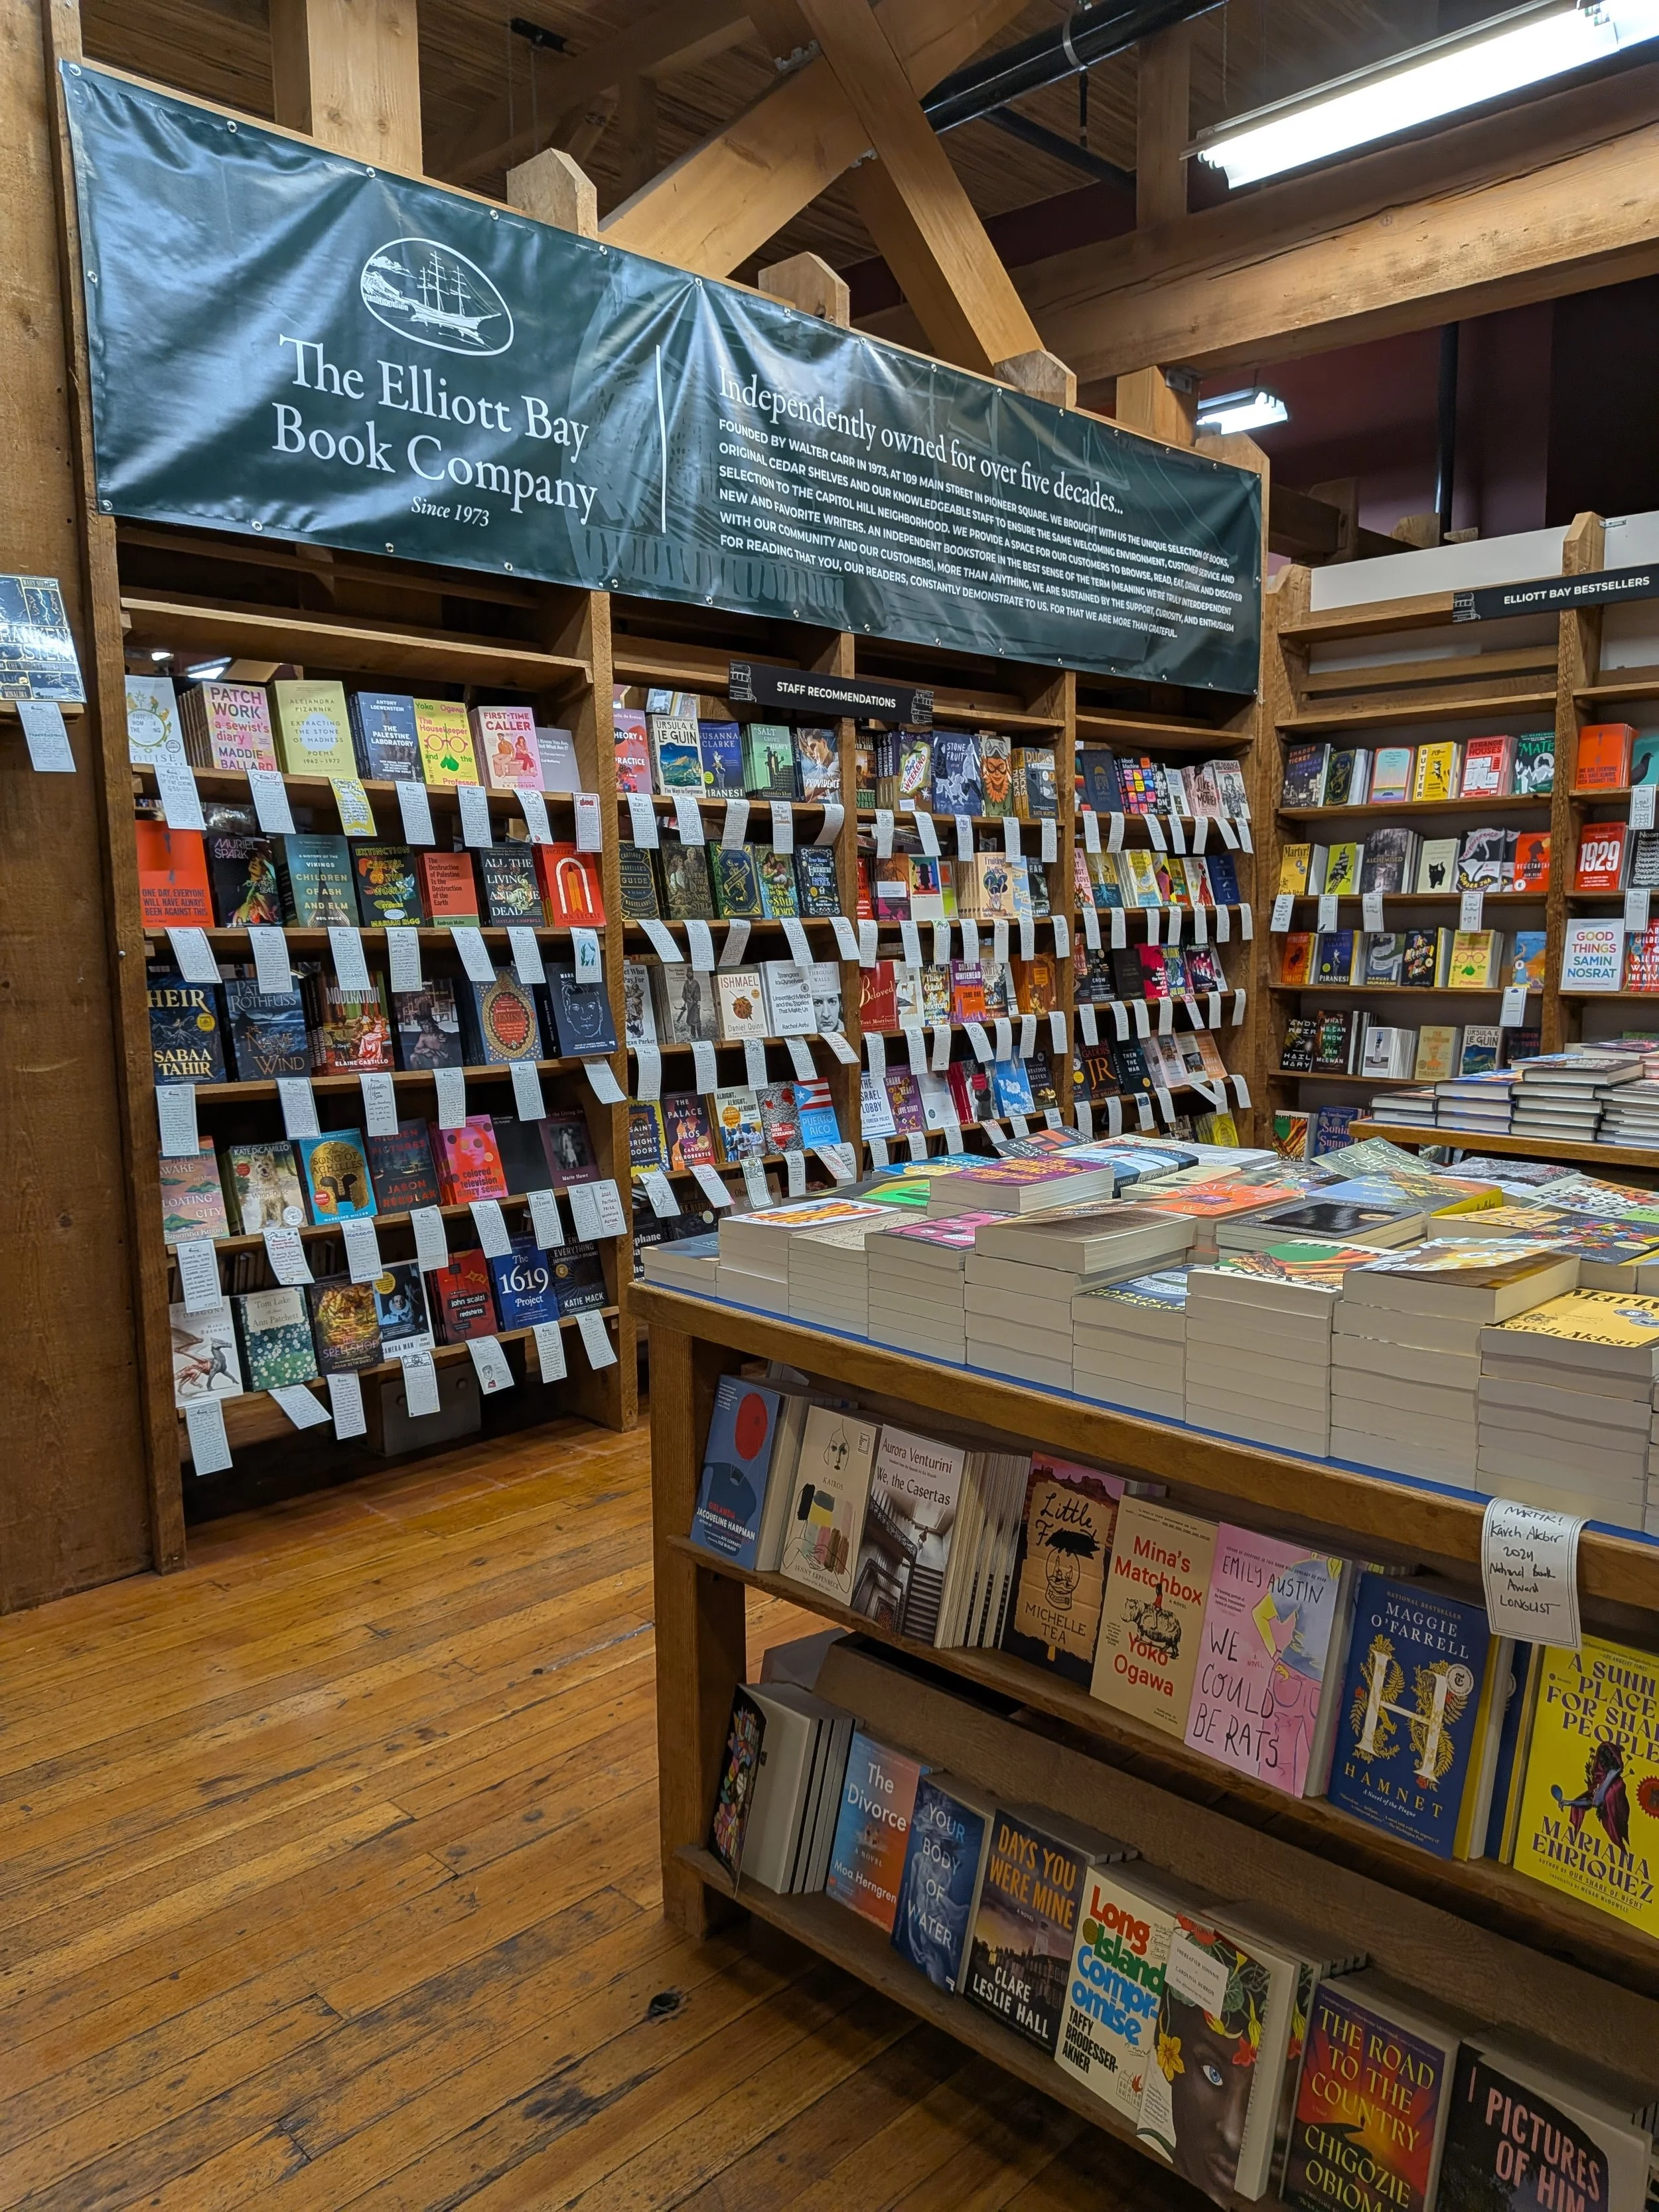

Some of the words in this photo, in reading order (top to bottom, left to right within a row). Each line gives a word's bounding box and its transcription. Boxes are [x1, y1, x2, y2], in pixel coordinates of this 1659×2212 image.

[279, 333, 364, 400] The
[378, 358, 512, 433] Elliott
[521, 394, 589, 463] Bay
[719, 365, 876, 451] Independently
[881, 427, 947, 463] owned
[950, 438, 976, 473] for
[980, 462, 1017, 484] over
[1021, 461, 1049, 494] five
[1053, 471, 1124, 515] decades...
[271, 402, 396, 473] Book
[406, 433, 597, 524] Company
[719, 419, 768, 444] FOUNDED
[771, 435, 786, 448] BY
[789, 439, 828, 460] WALTER
[830, 453, 855, 468] CARR
[857, 459, 866, 471] IN
[869, 461, 889, 479] 1973,
[891, 469, 901, 481] AT
[903, 473, 917, 484] 109
[920, 477, 944, 491] MAIN
[946, 483, 974, 498] STREET
[975, 492, 983, 504] IN
[985, 495, 1017, 513] PIONEER
[1018, 504, 1049, 522] SQUARE.
[1050, 514, 1062, 526] WE
[1063, 518, 1098, 534] BROUGHT
[1099, 526, 1117, 540] WITH
[1118, 532, 1127, 542] US
[1128, 534, 1140, 546] THE
[1141, 538, 1167, 552] UNIQUE
[1168, 544, 1202, 559] SELECTION
[1209, 553, 1229, 568] BOOKS,
[411, 495, 450, 519] Since
[454, 502, 489, 527] 1973
[1504, 591, 1547, 605] ELLIOTT
[1549, 587, 1572, 598] BAY
[1574, 576, 1650, 595] BESTSELLERS
[210, 687, 261, 705] PATCH
[212, 702, 261, 719] WORK
[776, 681, 806, 695] STAFF
[808, 686, 896, 708] RECOMMENDATIONS
[217, 731, 245, 745] diary
[226, 721, 269, 733] sewist's
[485, 721, 531, 731] CALLER
[656, 721, 688, 730] URSULA
[658, 729, 669, 743] LE
[671, 731, 697, 745] GUIN
[219, 747, 263, 761] MADDIE
[371, 738, 413, 747] LABORATORY
[947, 742, 966, 752] STONE
[947, 752, 964, 761] FRUIT
[1469, 747, 1501, 755] HOUSES
[221, 760, 273, 771] BALLARD
[215, 839, 257, 850] MURIEL
[215, 848, 248, 859] SPARK
[1579, 841, 1621, 872] 1929
[1572, 943, 1617, 953] THINGS
[1576, 931, 1614, 941] GOOD
[1567, 968, 1617, 978] NOSRAT
[1573, 956, 1612, 966] SAMIN
[721, 976, 758, 988] ISHMAEL
[859, 975, 895, 1007] Beloved
[147, 990, 211, 1013] HEIR
[728, 1023, 747, 1033] Daniel
[748, 1022, 764, 1031] Quinn
[154, 1049, 212, 1063] SABAA
[159, 1062, 215, 1078] TAHIR
[802, 1114, 833, 1126] PUERTO
[861, 1101, 881, 1112] LOBBY
[810, 1125, 830, 1136] RICO
[512, 1254, 529, 1265] The
[498, 1265, 549, 1294] 1619
[459, 1307, 483, 1318] redshirts
[466, 1295, 485, 1303] scalzi
[515, 1295, 543, 1307] Project
[564, 1297, 584, 1308] KATIE
[585, 1293, 605, 1303] MACK
[882, 1438, 906, 1460] Aurora
[910, 1445, 953, 1475] Venturini
[823, 1476, 843, 1491] KAIROS
[877, 1465, 890, 1487] We,
[892, 1475, 904, 1492] the
[906, 1479, 951, 1506] Casertas
[697, 1507, 727, 1528] JACQUELINE
[727, 1521, 755, 1541] HARPMAN
[1133, 1536, 1190, 1573] Mina's
[1503, 1546, 1534, 1562] 2024
[1114, 1556, 1202, 1606] Matchbox
[1222, 1555, 1263, 1588] EMILY
[1267, 1574, 1324, 1605] AUSTIN
[1025, 1601, 1086, 1637] MICHELLE
[1041, 1622, 1067, 1645] TEA
[1386, 1602, 1457, 1637] MAGGIE
[1127, 1631, 1169, 1666] Yoko
[1210, 1621, 1240, 1662] WE
[1372, 1614, 1469, 1659] O'FARRELL
[1114, 1654, 1174, 1697] Ogawa
[1201, 1663, 1274, 1719] COULD
[1193, 1702, 1222, 1744] BE
[1224, 1716, 1278, 1768] RATS
[867, 1762, 894, 1795] The
[1344, 1762, 1443, 1818] HAMNET
[847, 1783, 907, 1832] Divorce
[928, 1802, 966, 1843] YOUR
[922, 1837, 961, 1876] BODY
[998, 1824, 1038, 1870] DAYS
[1043, 1848, 1077, 1893] YOU
[1541, 1815, 1649, 1880] MARIANA
[833, 1859, 853, 1881] Moa
[855, 1873, 897, 1905] Herngren
[1532, 1832, 1654, 1904] ENRIQUEZ
[926, 1879, 946, 1903] OF
[989, 1856, 1032, 1906] WERE
[1033, 1885, 1075, 1931] MINE
[908, 1903, 952, 1950] WATER
[1090, 1885, 1151, 1955] Long
[1094, 1923, 1167, 1996] Island
[995, 1965, 1032, 2002] CLARE
[973, 1974, 1013, 2014] LESLIE
[1016, 2003, 1049, 2039] HALL
[1070, 2006, 1094, 2035] TAFFY
[1063, 2041, 1091, 2074] AKNER
[1066, 2025, 1118, 2073] BRODESSER-
[1319, 2005, 1363, 2051] THE
[1368, 2035, 1434, 2089] ROAD
[1329, 2044, 1358, 2081] TO
[1366, 2067, 1413, 2114] THE
[1311, 2072, 1420, 2153] COUNTRY
[1485, 2087, 1601, 2203] PICTURES
[1305, 2125, 1410, 2209] CHIGOZIE
[1496, 2140, 1530, 2187] OF
